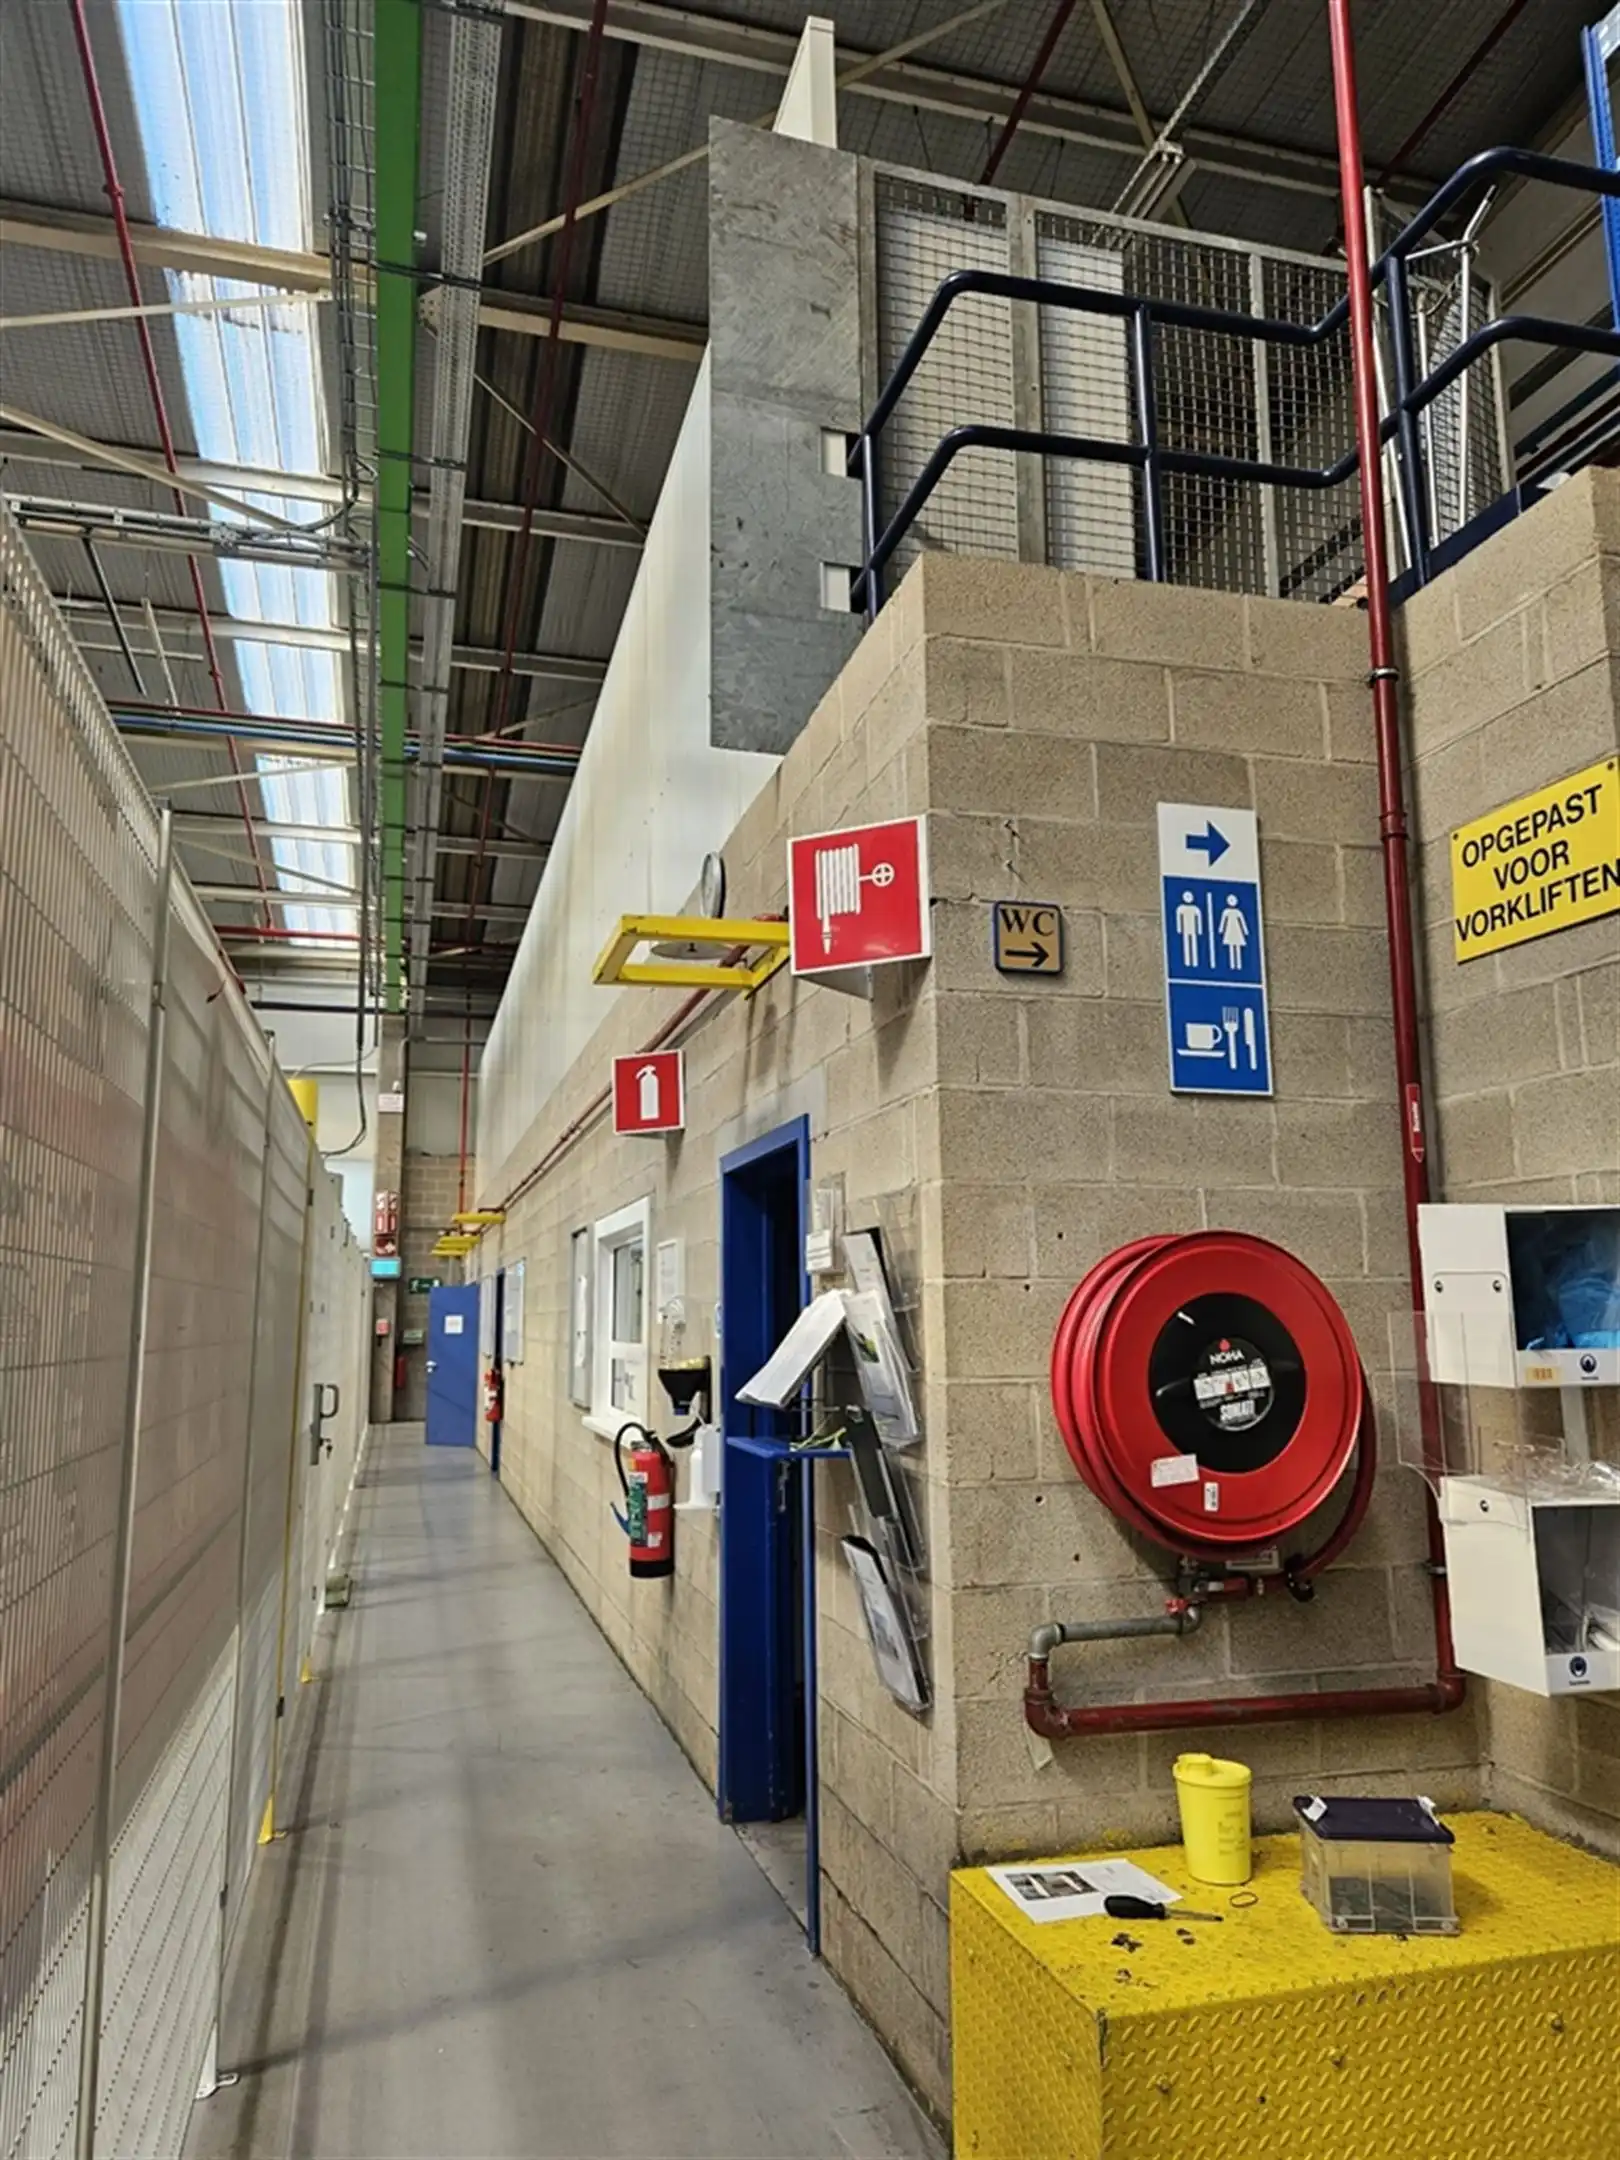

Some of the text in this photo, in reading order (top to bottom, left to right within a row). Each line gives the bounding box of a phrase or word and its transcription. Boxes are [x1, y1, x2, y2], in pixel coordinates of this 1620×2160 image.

[1462, 783, 1603, 868] OPGEPAST
[1493, 839, 1570, 891] VOOR
[1000, 908, 1055, 937] WC
[1456, 858, 1620, 942] VORKLIFTEN
